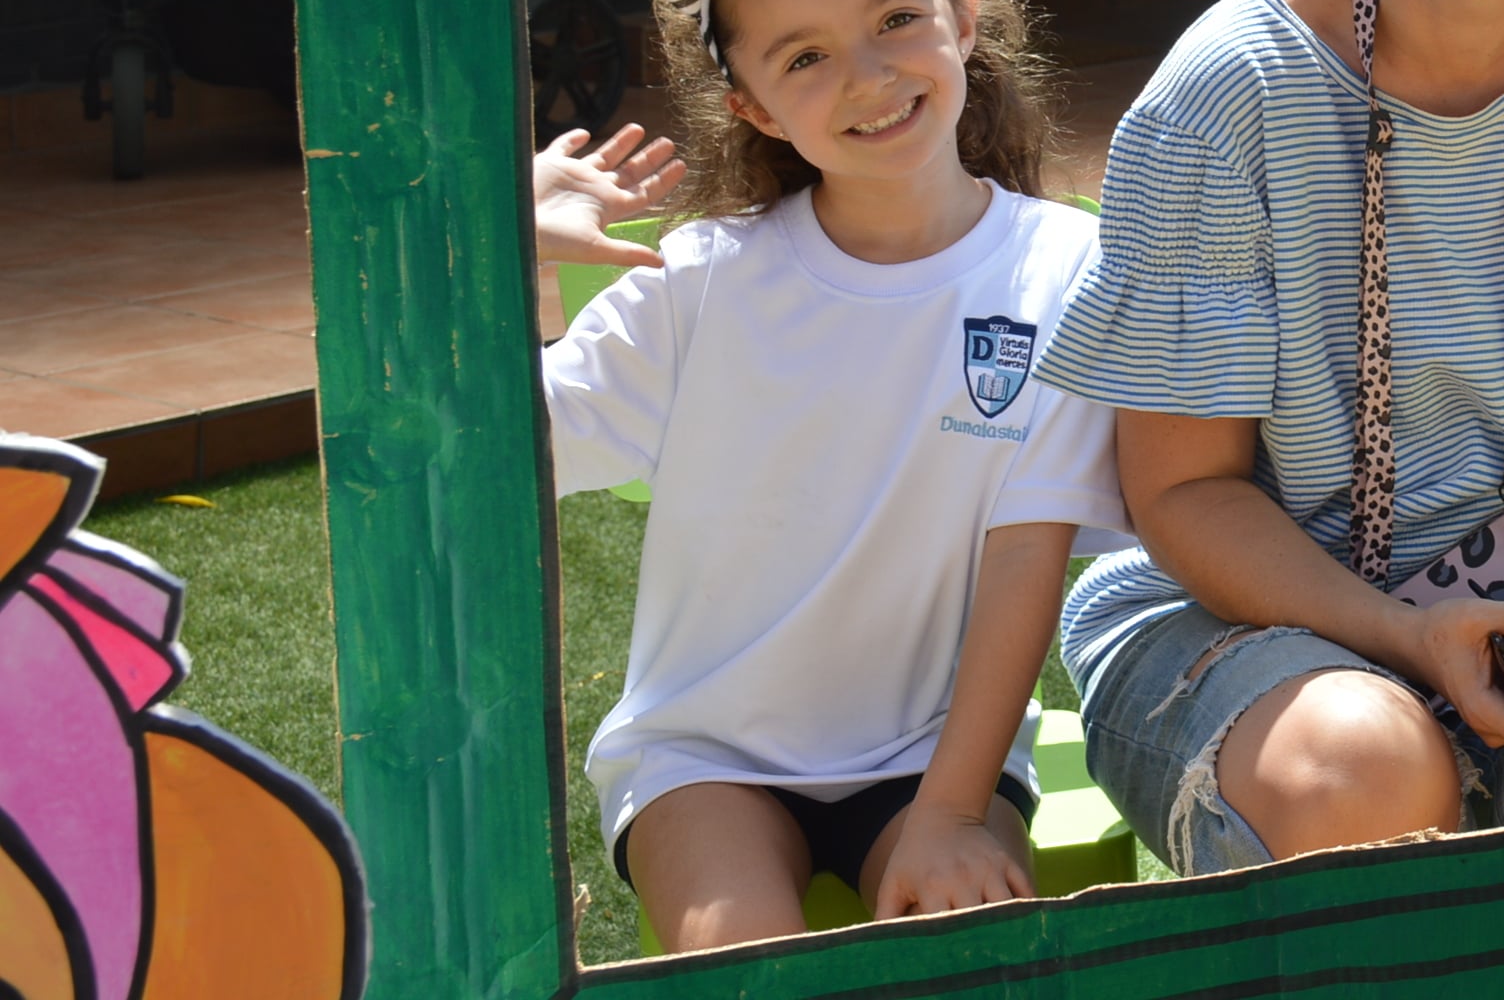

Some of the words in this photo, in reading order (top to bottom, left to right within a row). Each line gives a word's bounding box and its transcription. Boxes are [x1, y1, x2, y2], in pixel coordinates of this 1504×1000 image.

[988, 323, 1011, 334] 1937
[971, 335, 994, 361] D
[999, 346, 1028, 360] Gloria
